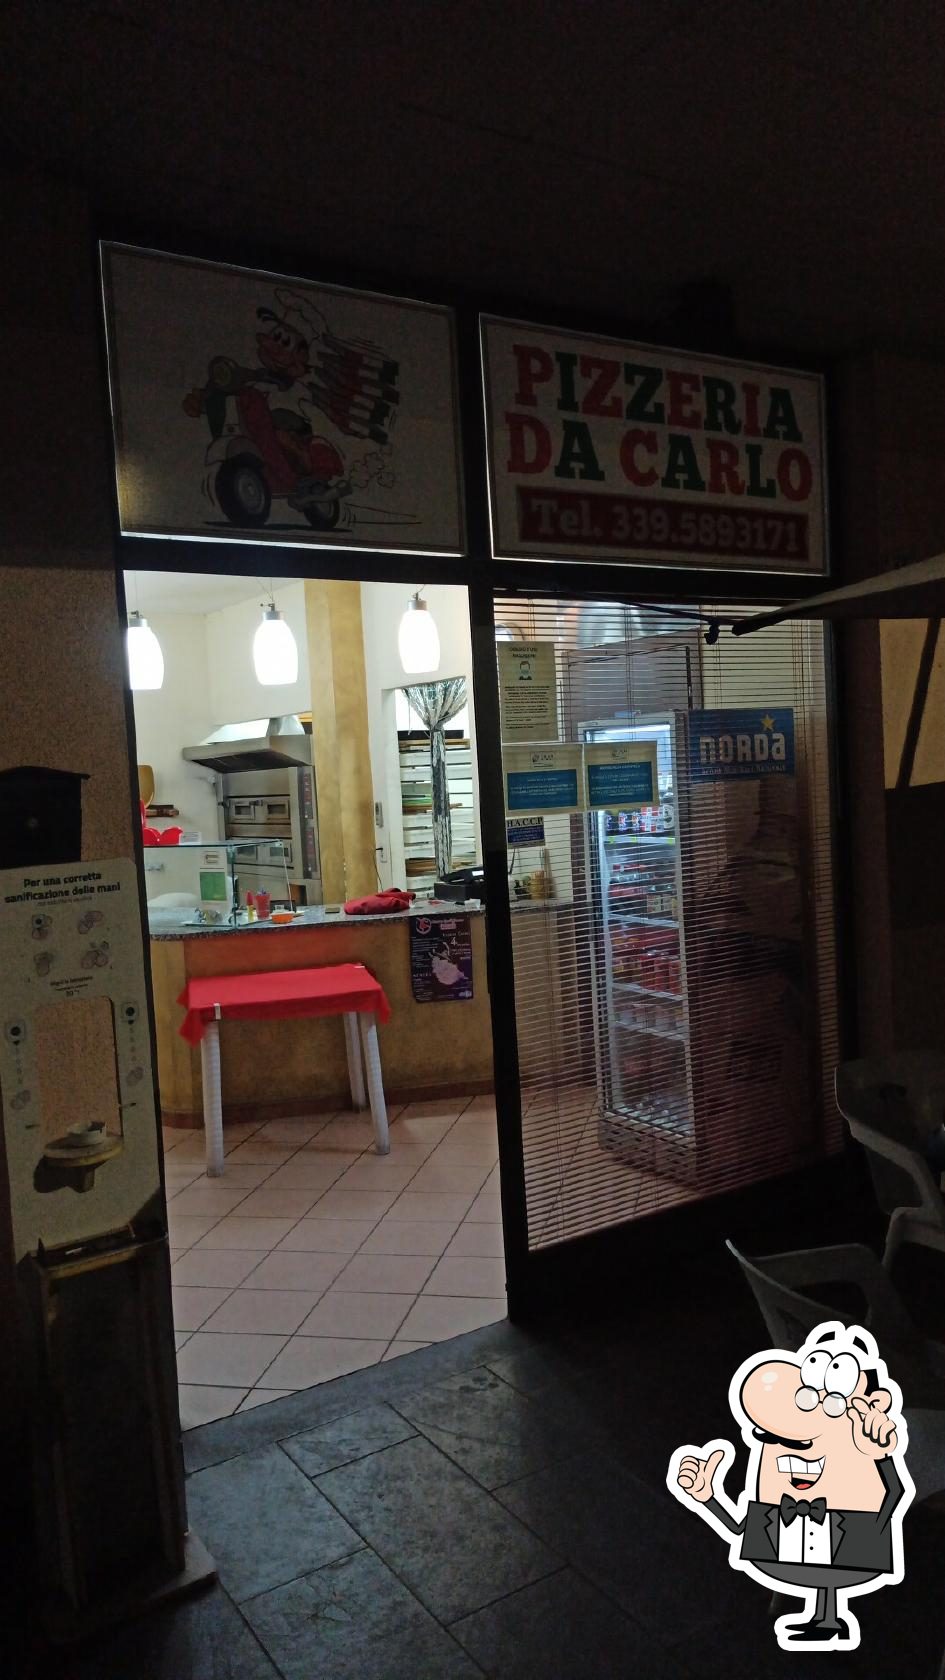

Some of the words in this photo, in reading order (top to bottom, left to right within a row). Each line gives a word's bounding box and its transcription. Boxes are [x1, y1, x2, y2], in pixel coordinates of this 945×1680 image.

[512, 344, 803, 442] PIZZERIA
[505, 412, 606, 482] DA
[620, 428, 812, 501] CARLO
[531, 497, 604, 535] Tel.
[612, 505, 799, 553] 339.5893171
[4, 889, 70, 903] sanificazione
[72, 886, 95, 895] delle
[97, 882, 121, 893] mani
[23, 878, 41, 888] Per
[43, 877, 61, 886] una
[63, 872, 102, 884] corretta
